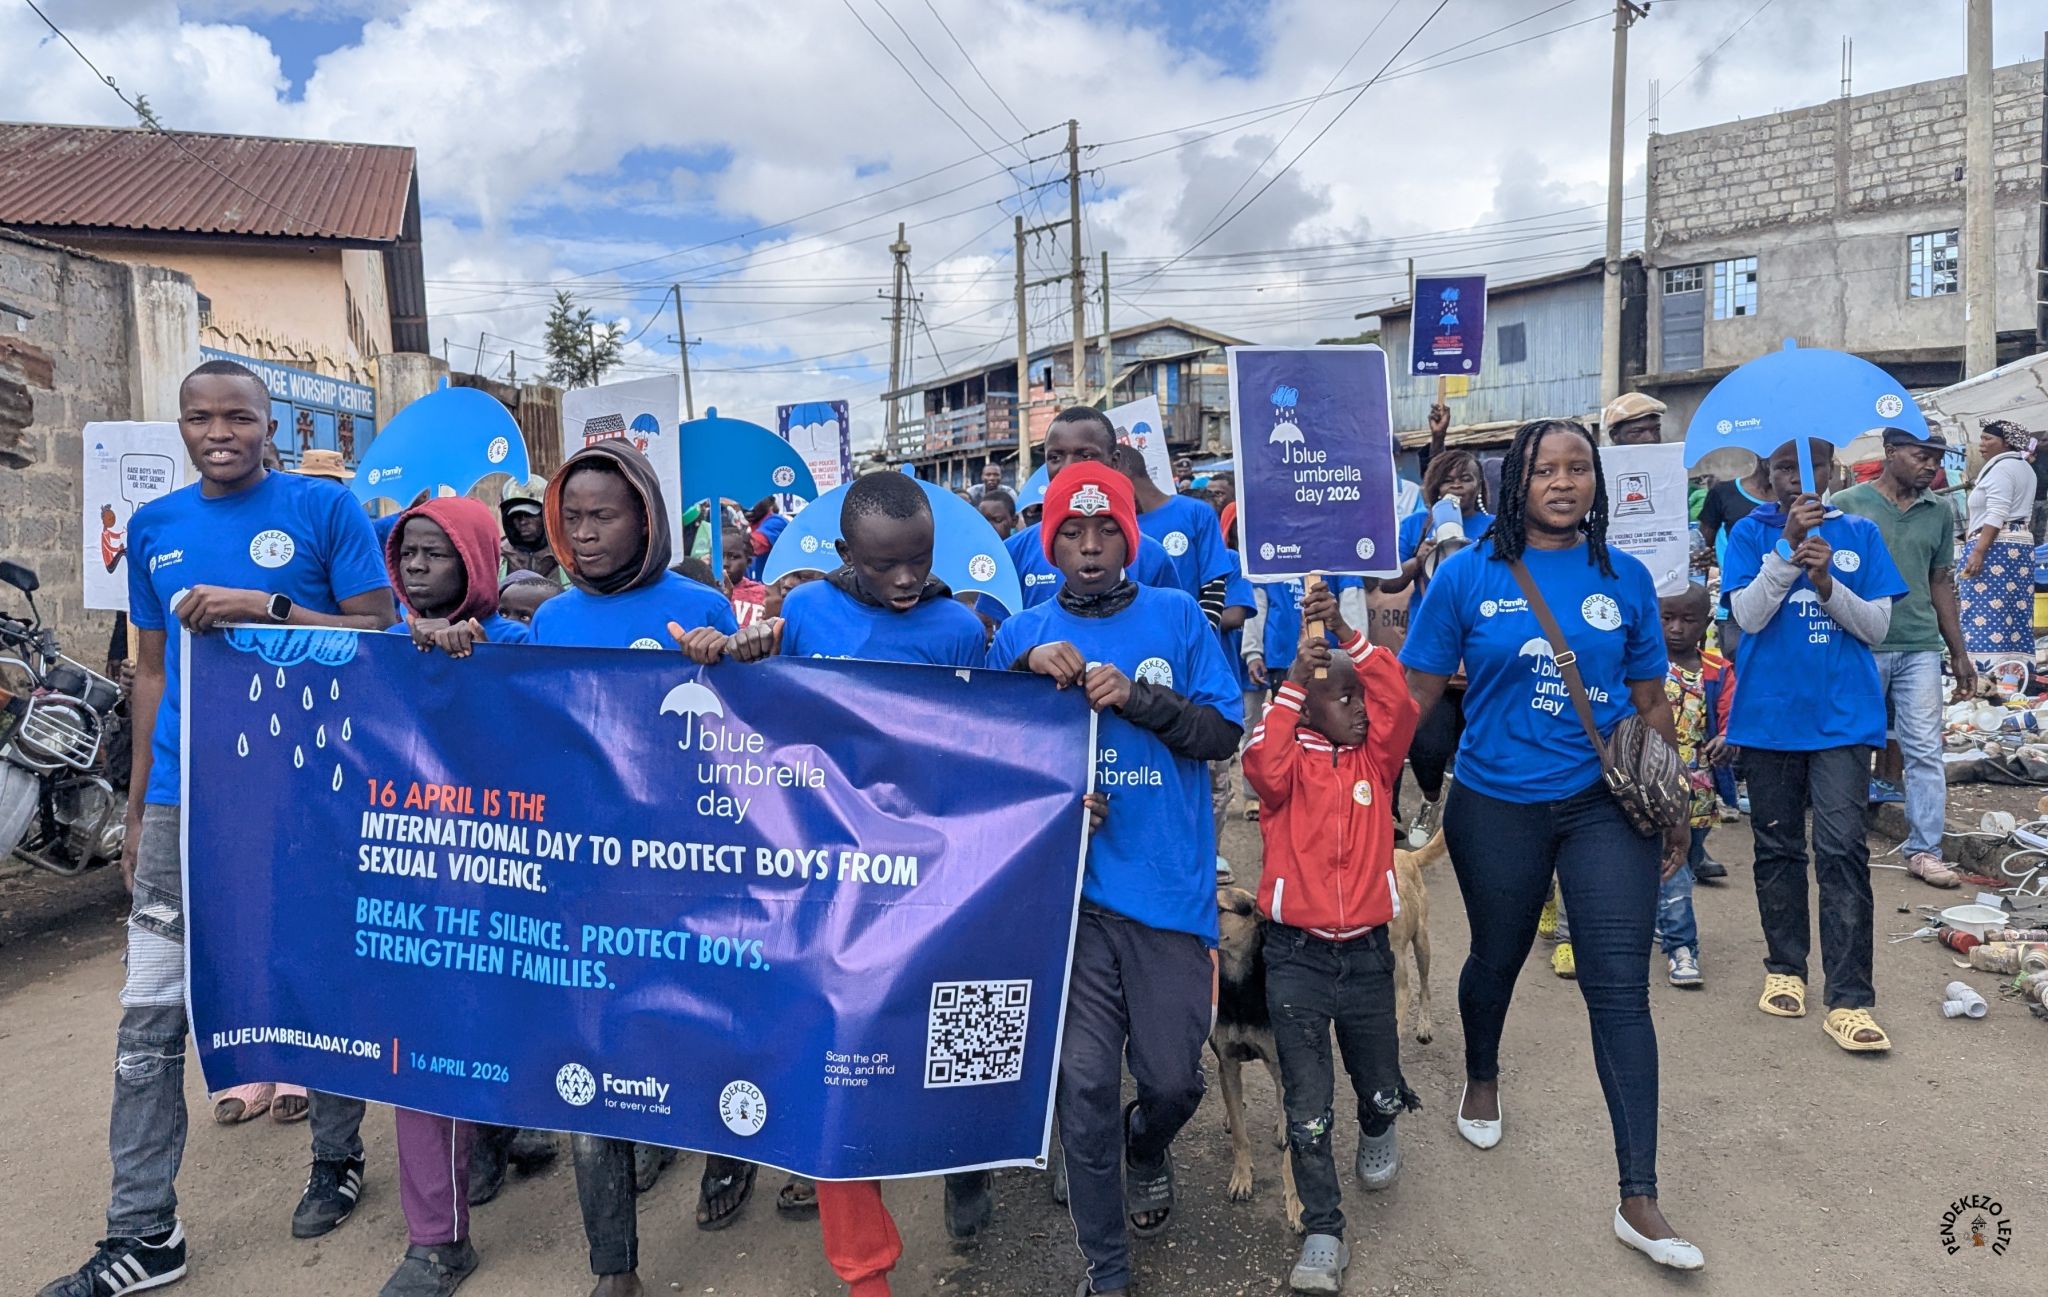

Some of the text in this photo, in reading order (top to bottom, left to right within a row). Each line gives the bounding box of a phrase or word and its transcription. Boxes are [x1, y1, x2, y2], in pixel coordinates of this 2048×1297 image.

[289, 372, 337, 404] WORSHIP
[338, 385, 372, 412] CENTRE
[1735, 418, 1761, 427] Family
[1293, 447, 1327, 464] blue
[382, 466, 402, 476] Family
[1294, 466, 1361, 483] umbrella
[1295, 487, 1360, 505] day 2026
[158, 550, 184, 563] Family
[253, 532, 292, 561] PENDEKEZO LETU
[1277, 545, 1301, 554] Family
[1499, 599, 1528, 607] Family
[1584, 596, 1620, 626] PENDEKEZO LETU
[1541, 661, 1562, 678] blu
[1531, 696, 1564, 715] day
[700, 724, 764, 753] blue
[698, 759, 825, 788] umbrella
[368, 779, 546, 822] 16 APRIL IS THE
[697, 790, 751, 824] day
[361, 811, 918, 887] INTERNATIONAL DAY TO PROTECT BOYS FROM
[359, 845, 547, 893] SEXUAL VIOLENCE.
[356, 896, 770, 971] BREAK THE SILENCE. PROTECT BOYS.
[355, 929, 615, 989] STRENGTHEN FAMILIES.
[213, 1027, 380, 1059] BLUEUMBRELLADAY.ORG
[826, 1051, 888, 1063] Scan the QR
[411, 1052, 509, 1082] 16 APRIL 2026
[824, 1076, 868, 1086] out more
[825, 1064, 895, 1075] code, and find
[602, 1073, 670, 1102] Family
[605, 1098, 671, 1114] for every child
[722, 1083, 764, 1128] PENDEKEZO LETU
